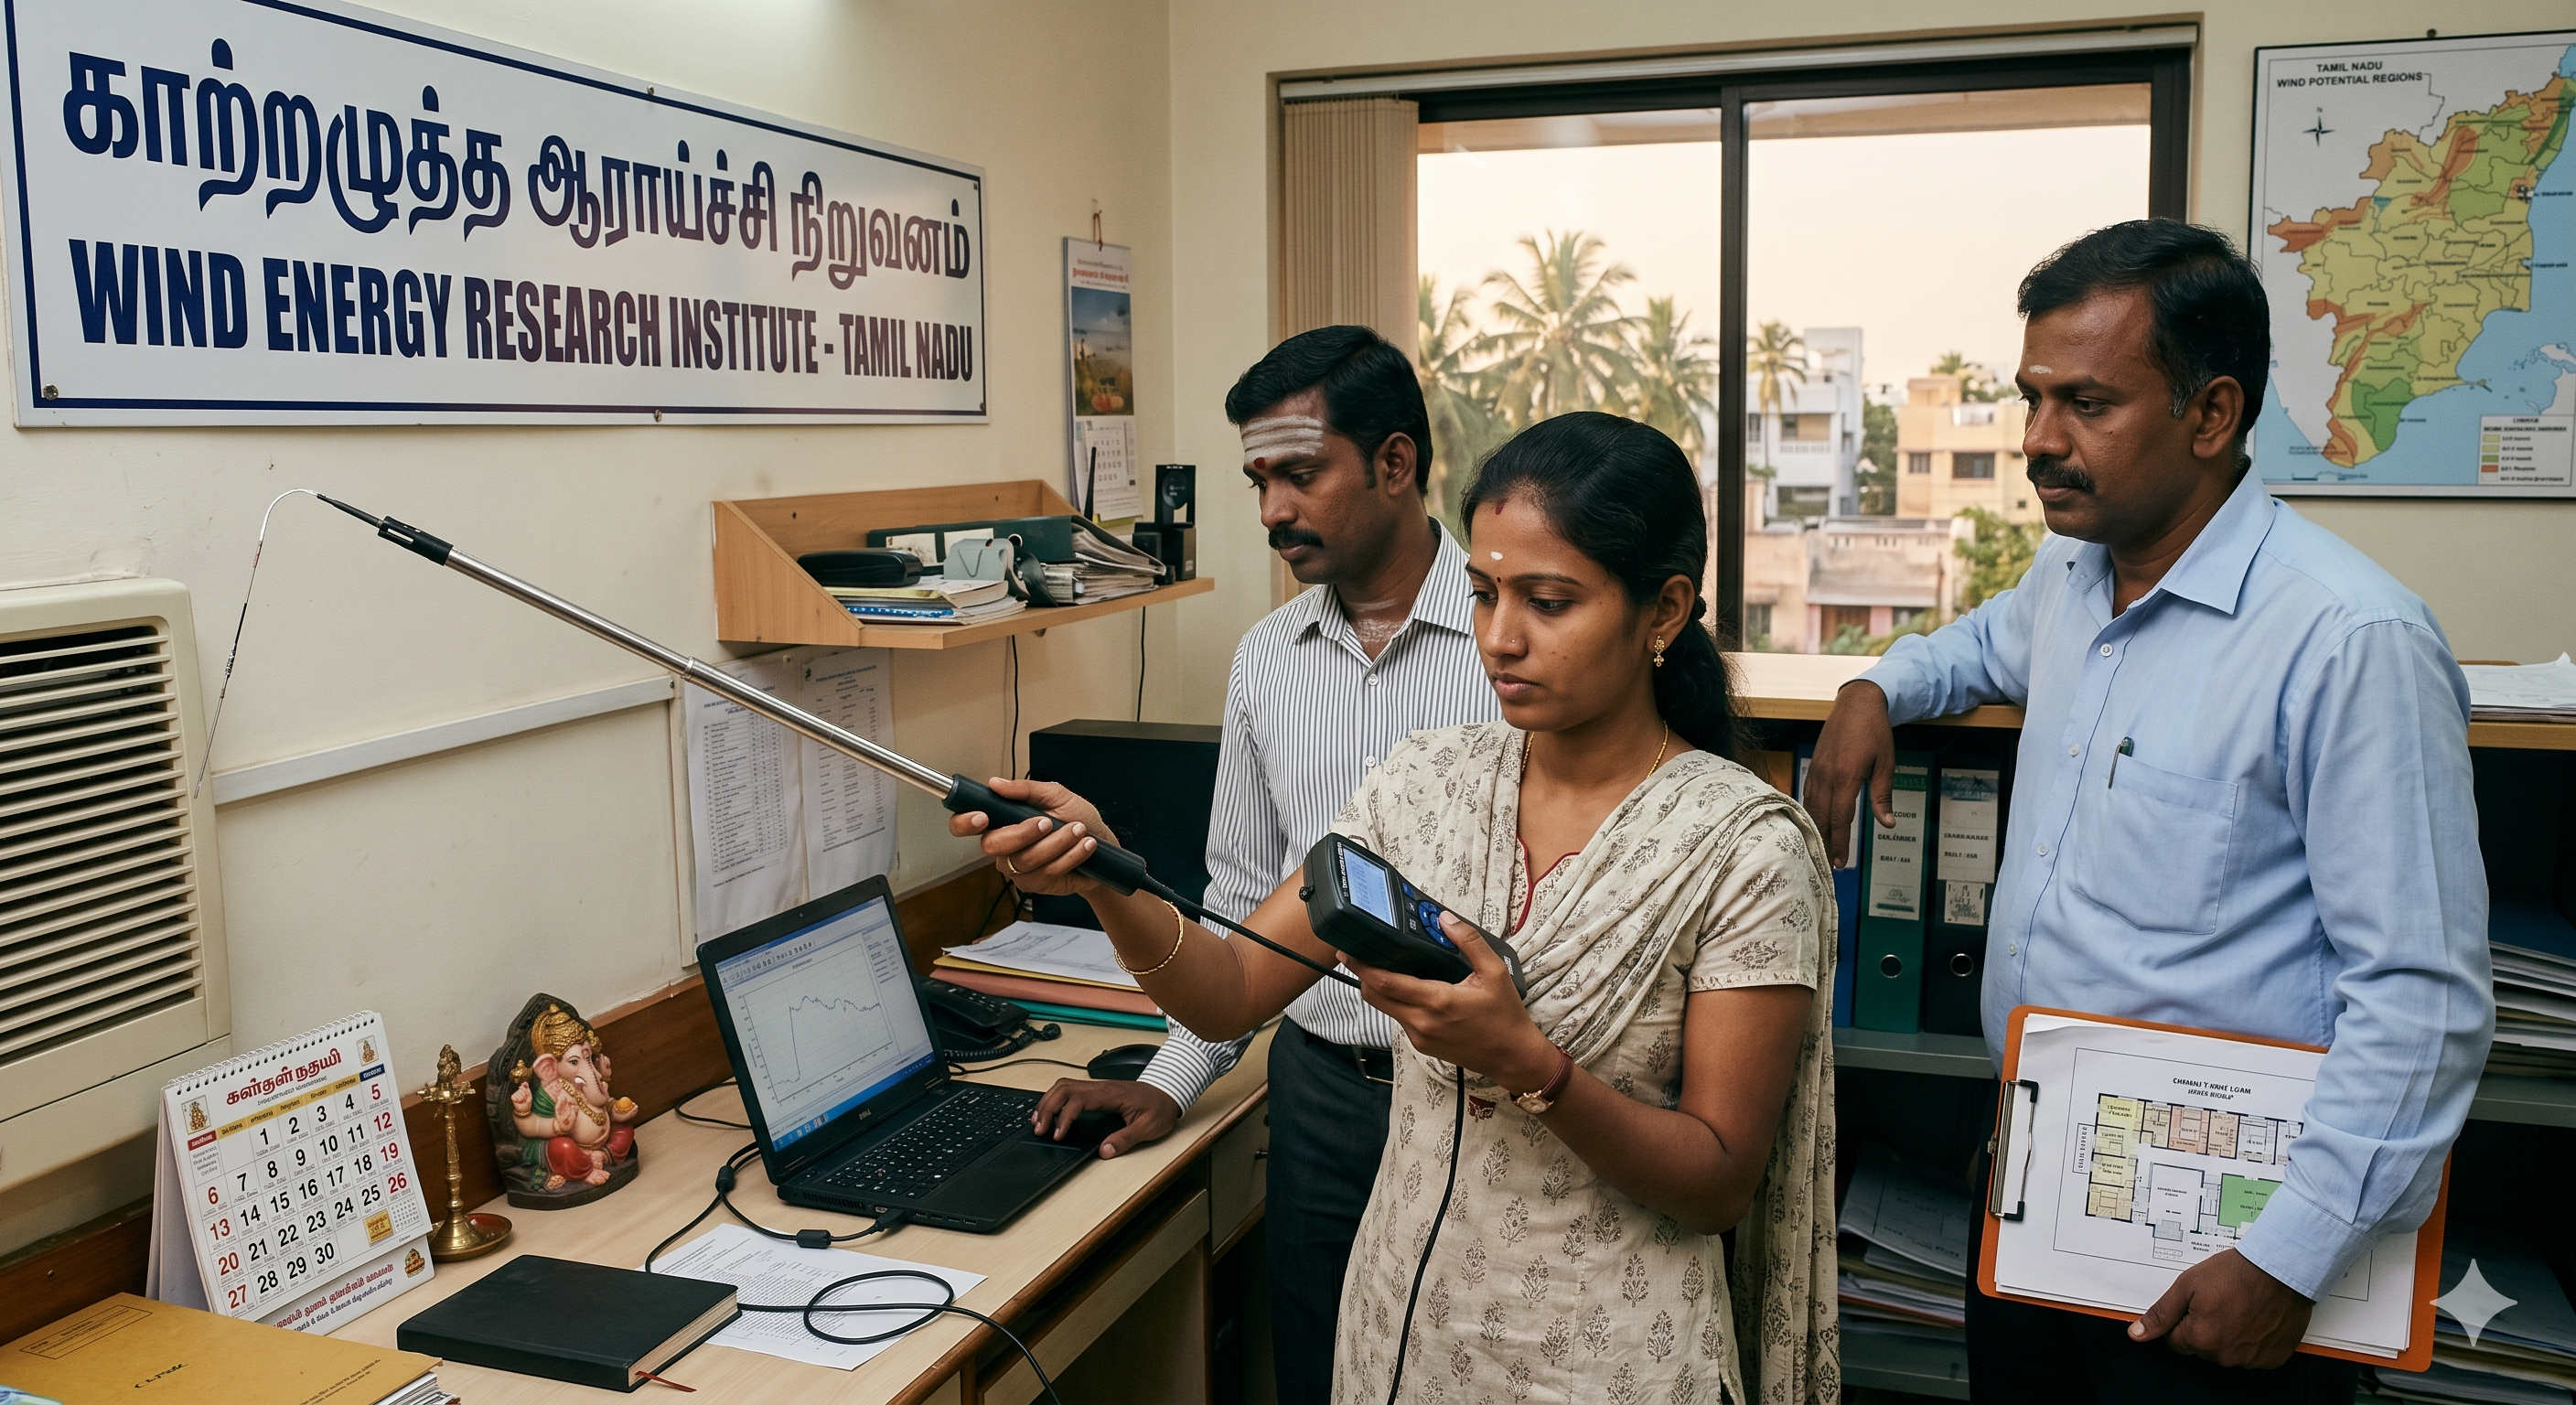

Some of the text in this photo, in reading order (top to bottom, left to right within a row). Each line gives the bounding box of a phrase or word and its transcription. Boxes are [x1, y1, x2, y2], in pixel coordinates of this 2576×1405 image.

[2277, 72, 2423, 88] WIND POTENTIAL REGIONS
[2316, 61, 2383, 72] TAMIL NADU
[62, 38, 971, 291] காற்றழுத்த ஆராய்ச்சி நிறுவனம்
[68, 238, 249, 349] WIND
[264, 256, 453, 359] ENERGY
[464, 275, 661, 368] RESEARCH
[669, 296, 819, 374] INSTITUTE
[839, 313, 912, 379] TAMIL
[915, 321, 973, 382] NADU
[208, 1111, 392, 1206] 6 7 8 9 10 11 12
[260, 1128, 269, 1146] 1
[288, 1116, 300, 1135] 2
[317, 1105, 327, 1122] 3
[345, 1093, 355, 1110] 4
[370, 1083, 381, 1100] 5
[209, 1142, 399, 1241] 13 14 15 16 17 18 19
[218, 1172, 407, 1277] 20 21 22 23 24 25 26
[228, 1242, 335, 1310] 27 28 29 30
